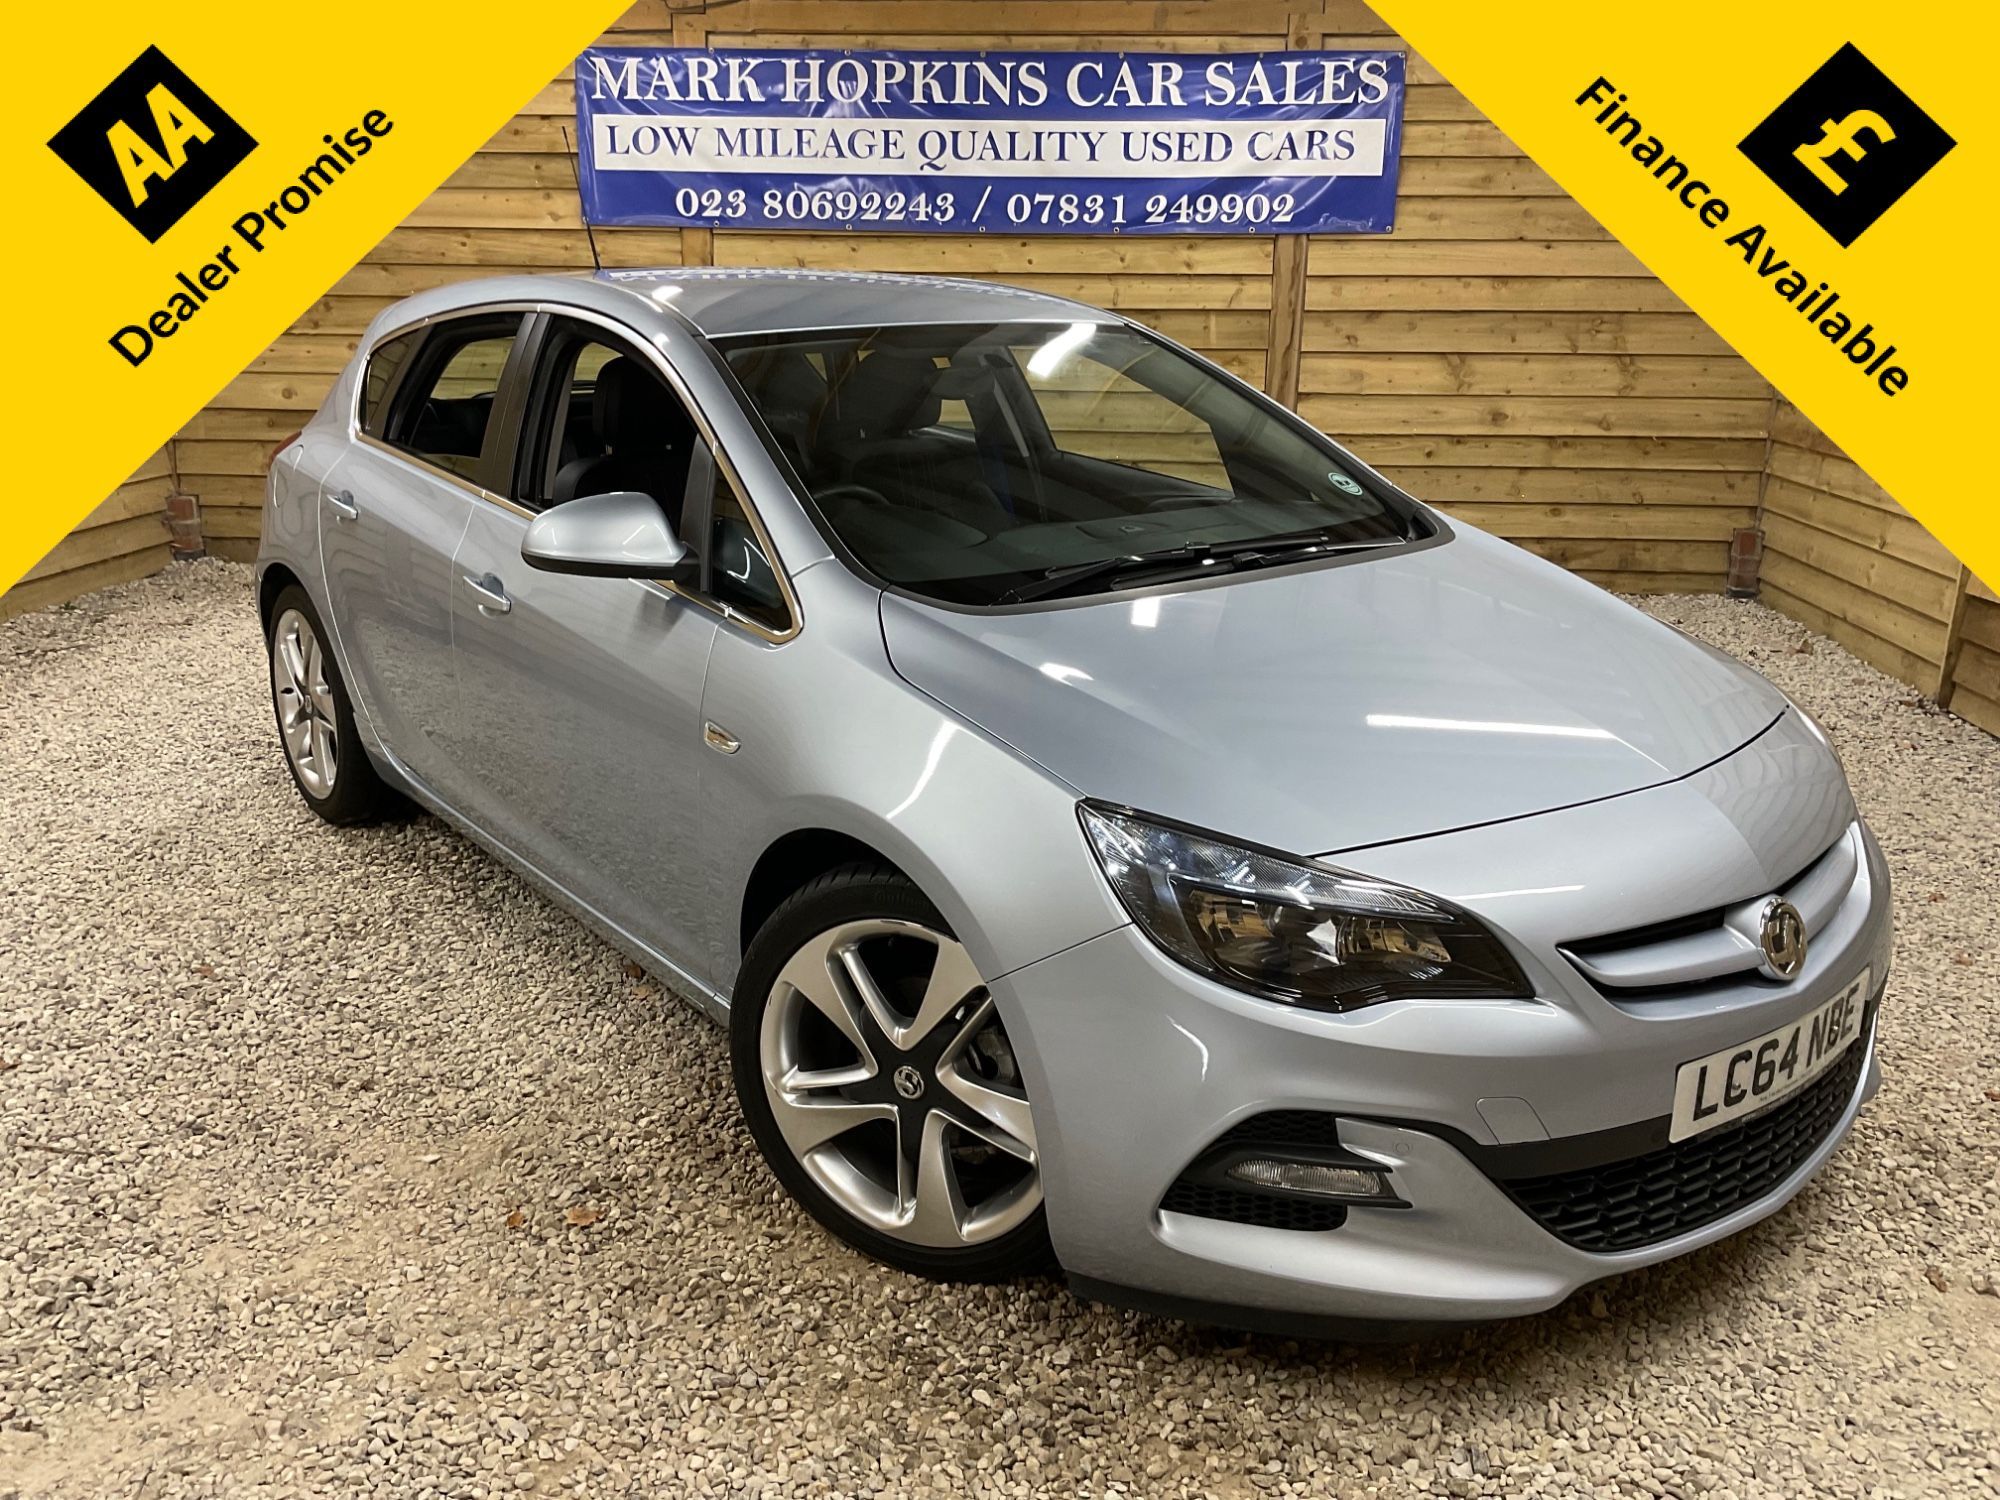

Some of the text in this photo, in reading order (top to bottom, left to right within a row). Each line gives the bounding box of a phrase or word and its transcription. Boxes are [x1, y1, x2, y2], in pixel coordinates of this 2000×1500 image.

[591, 56, 1389, 107] MARK HOPKINS CAR SALES
[606, 125, 1355, 172] LOW MILEAGE QUALITY USED CARS
[676, 188, 747, 218] 023
[763, 189, 955, 222] 80692243
[1006, 194, 1127, 223] 07831
[1145, 194, 1295, 223] 249902
[1693, 1026, 1802, 1121] LC64
[1806, 983, 1860, 1068] NBE
